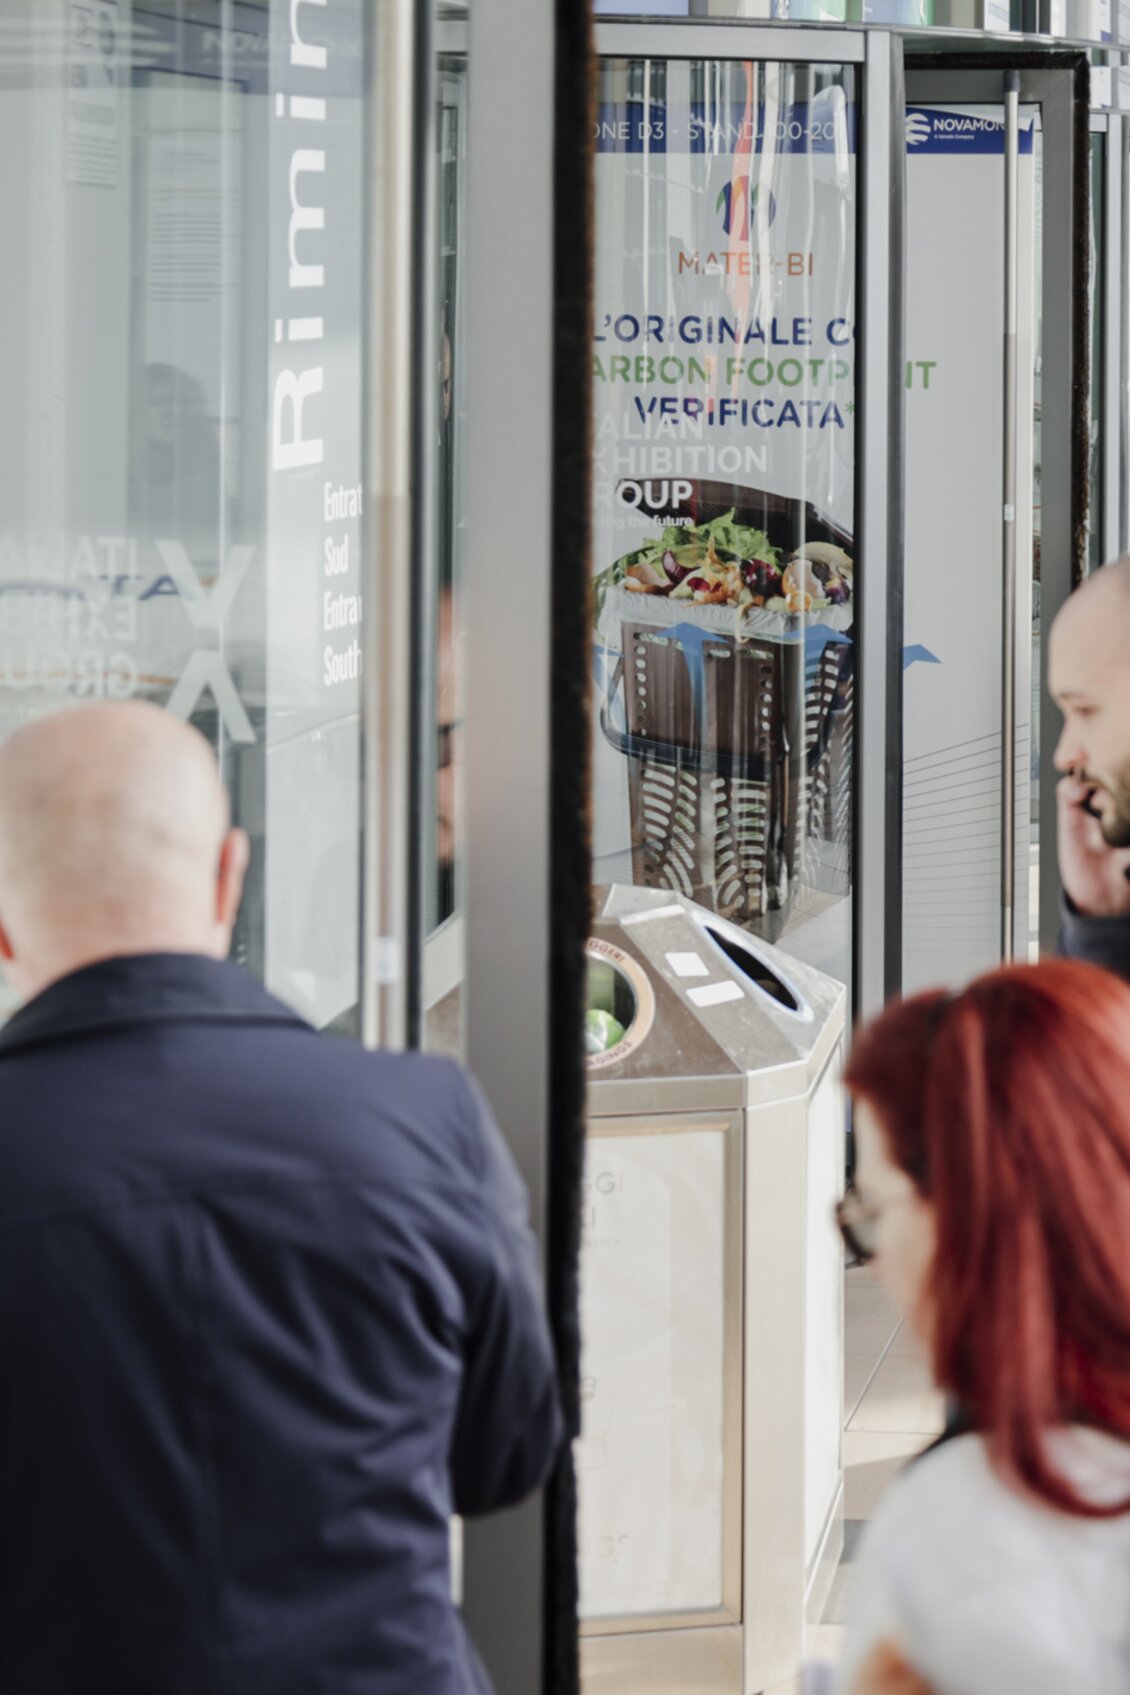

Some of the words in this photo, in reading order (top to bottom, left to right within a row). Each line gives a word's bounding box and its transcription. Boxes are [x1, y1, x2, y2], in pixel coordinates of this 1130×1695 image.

[637, 121, 664, 140] D3
[678, 252, 813, 276] MATER-BI
[653, 514, 693, 527] future
[324, 533, 348, 576] Sud
